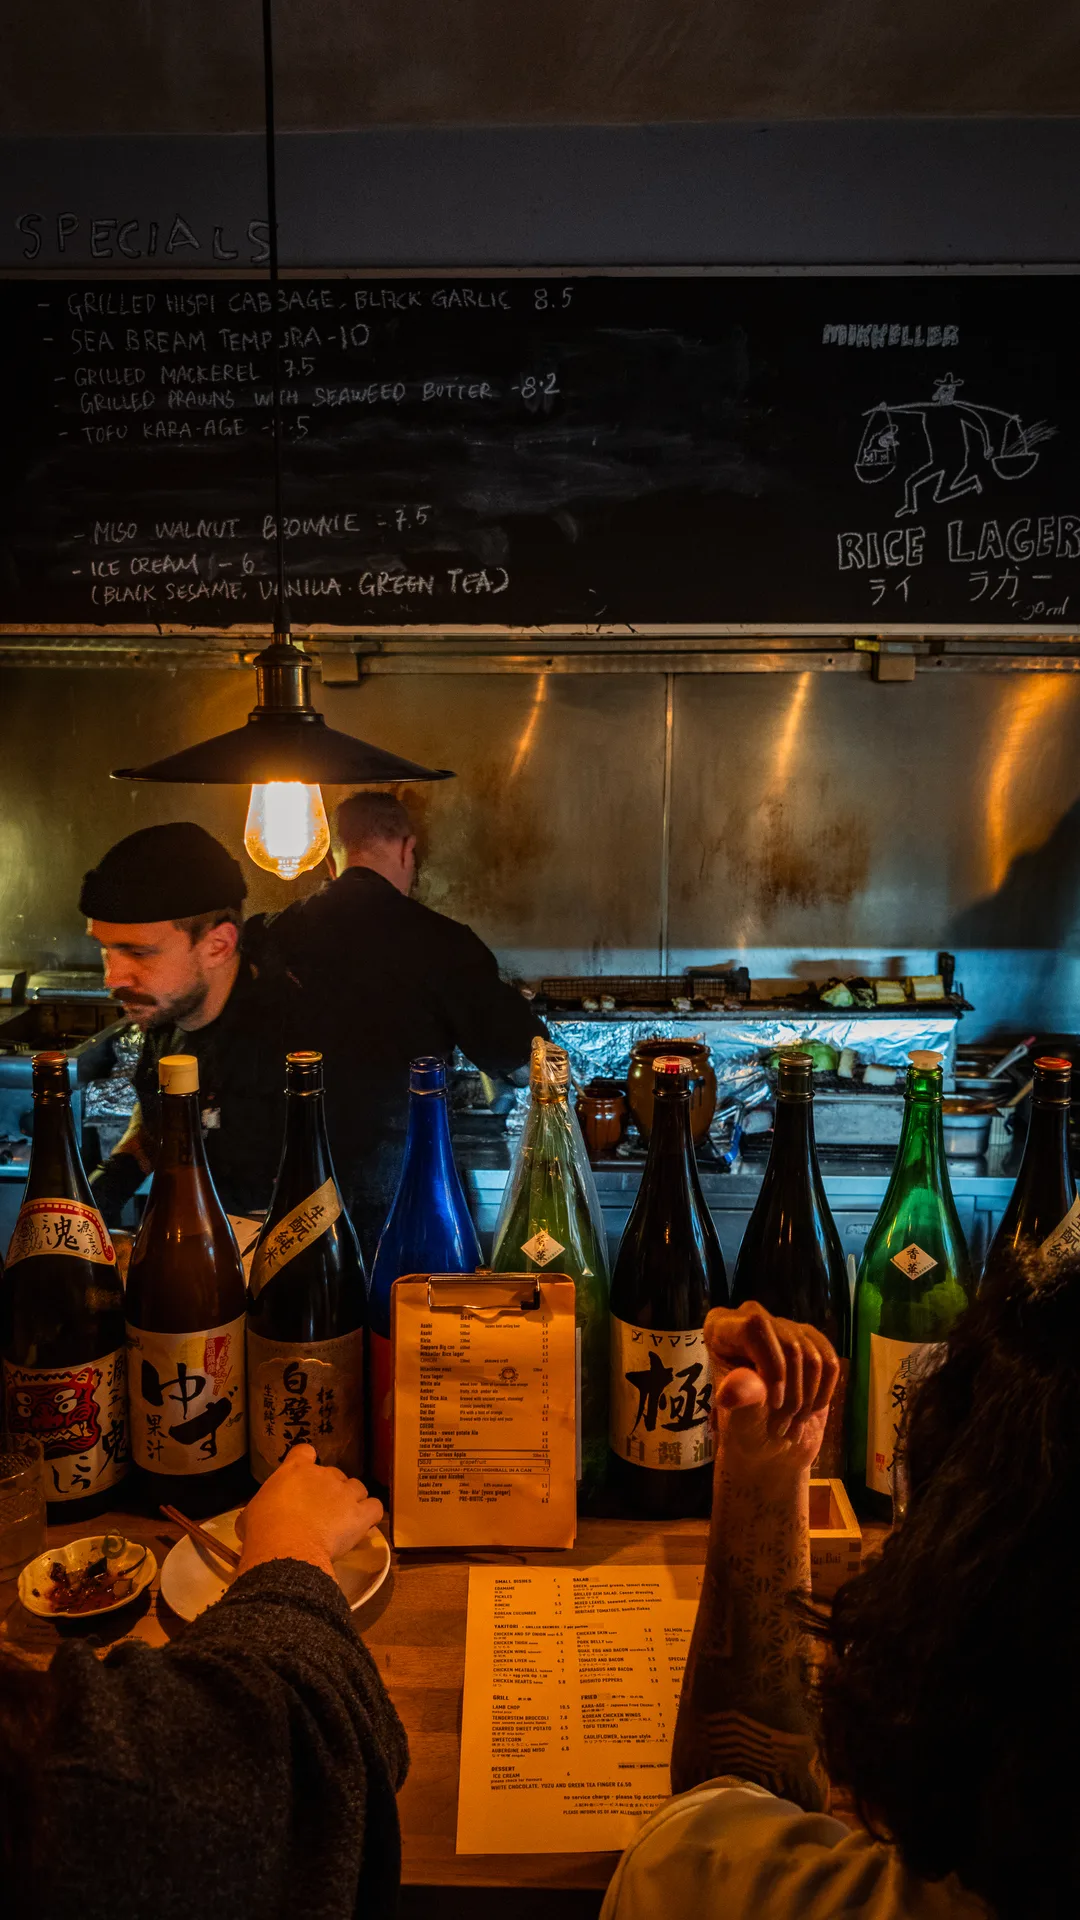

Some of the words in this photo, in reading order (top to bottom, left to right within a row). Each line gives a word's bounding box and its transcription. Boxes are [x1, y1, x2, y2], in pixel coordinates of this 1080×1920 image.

[19, 213, 276, 263] SPECIALS
[68, 293, 156, 321] GRILLED
[166, 293, 216, 316] HISPI
[431, 289, 512, 311] GARLIC
[533, 287, 575, 311] 8.5
[71, 329, 116, 355] SEA
[126, 329, 208, 354] BREAM
[822, 323, 960, 349] MIKKELLER
[74, 367, 146, 388] GRILLED
[160, 361, 262, 385] MACKEREL
[284, 356, 317, 379] 7.5
[80, 389, 157, 415] GRILLED
[167, 390, 235, 409] PRAWNS
[311, 383, 407, 408] SEAWEED
[422, 382, 492, 403] BUTTER
[81, 425, 128, 445] TOFU
[143, 418, 246, 441] KARA-AGE
[95, 520, 139, 545] MISO
[155, 518, 241, 540] WALNUT
[837, 525, 926, 570] RICE
[947, 515, 1080, 563] LAGER
[91, 561, 121, 578] ICE
[130, 553, 201, 577] CREAM
[357, 571, 435, 598] GREEN
[447, 567, 511, 596] TEA)
[968, 565, 1053, 602] ラガー
[141, 1358, 239, 1462] ゆず
[146, 1413, 168, 1462] 果汁
